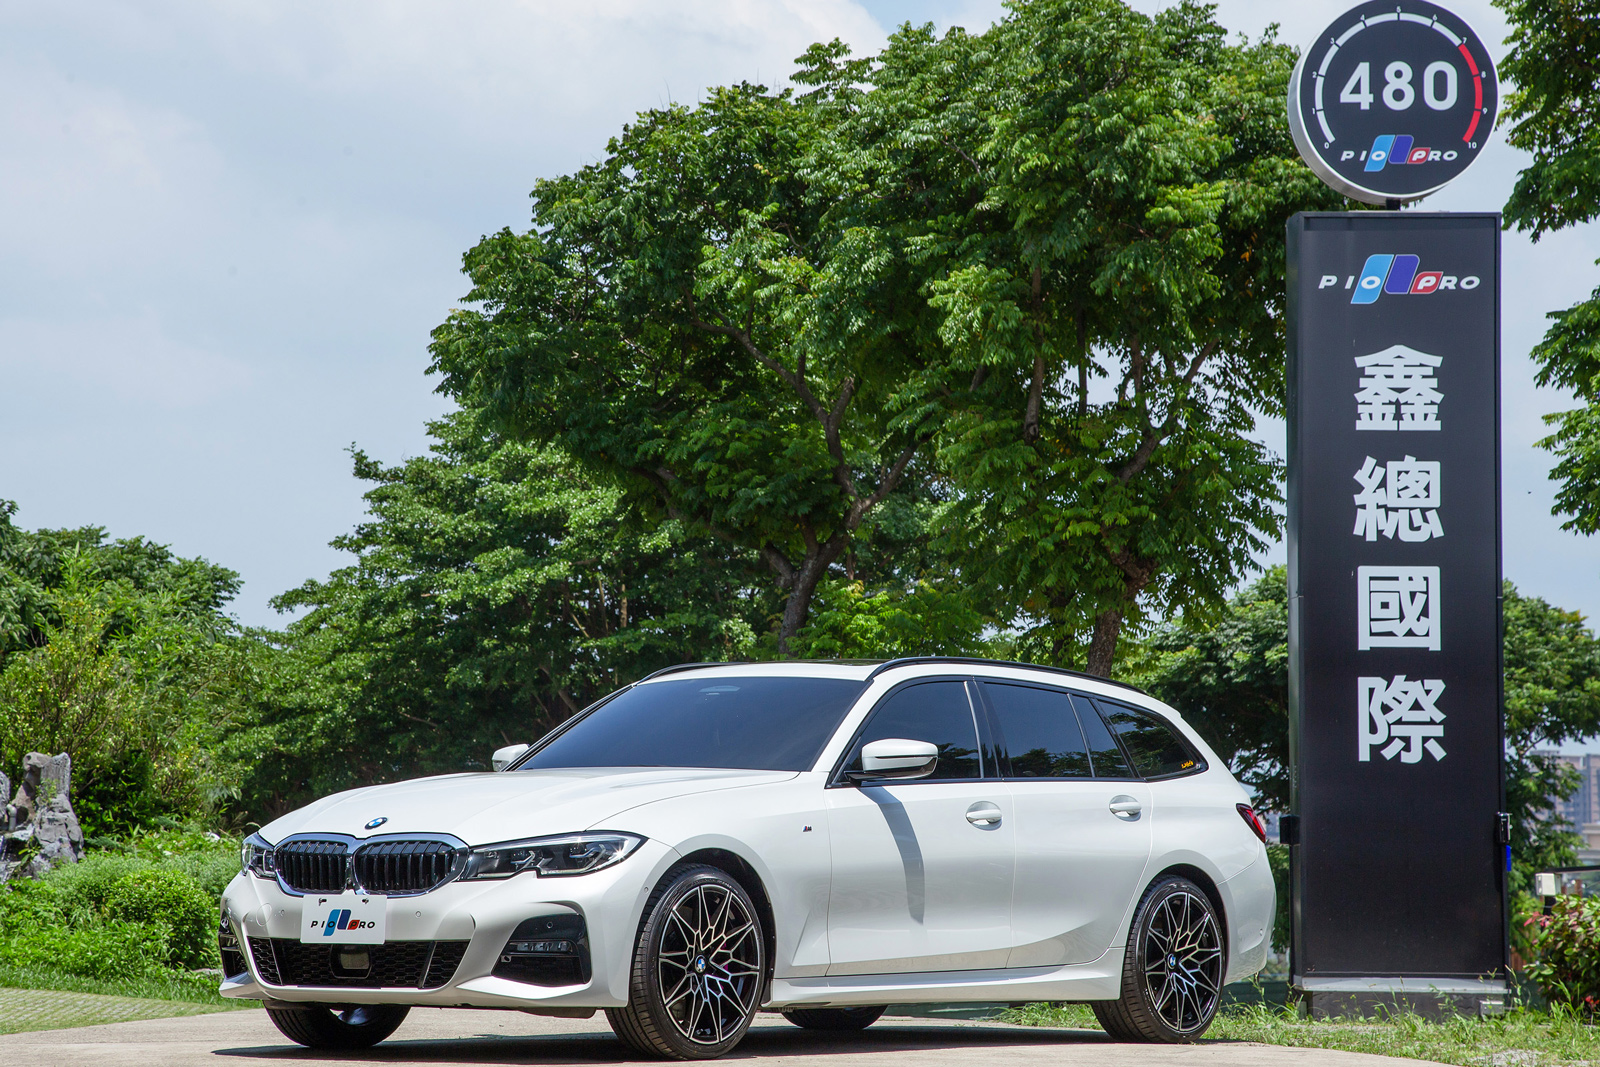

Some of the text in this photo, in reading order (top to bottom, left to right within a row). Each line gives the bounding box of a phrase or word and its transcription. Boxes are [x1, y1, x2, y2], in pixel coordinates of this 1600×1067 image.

[1340, 61, 1458, 111] 480
[1353, 344, 1447, 764] 鑫總國際
